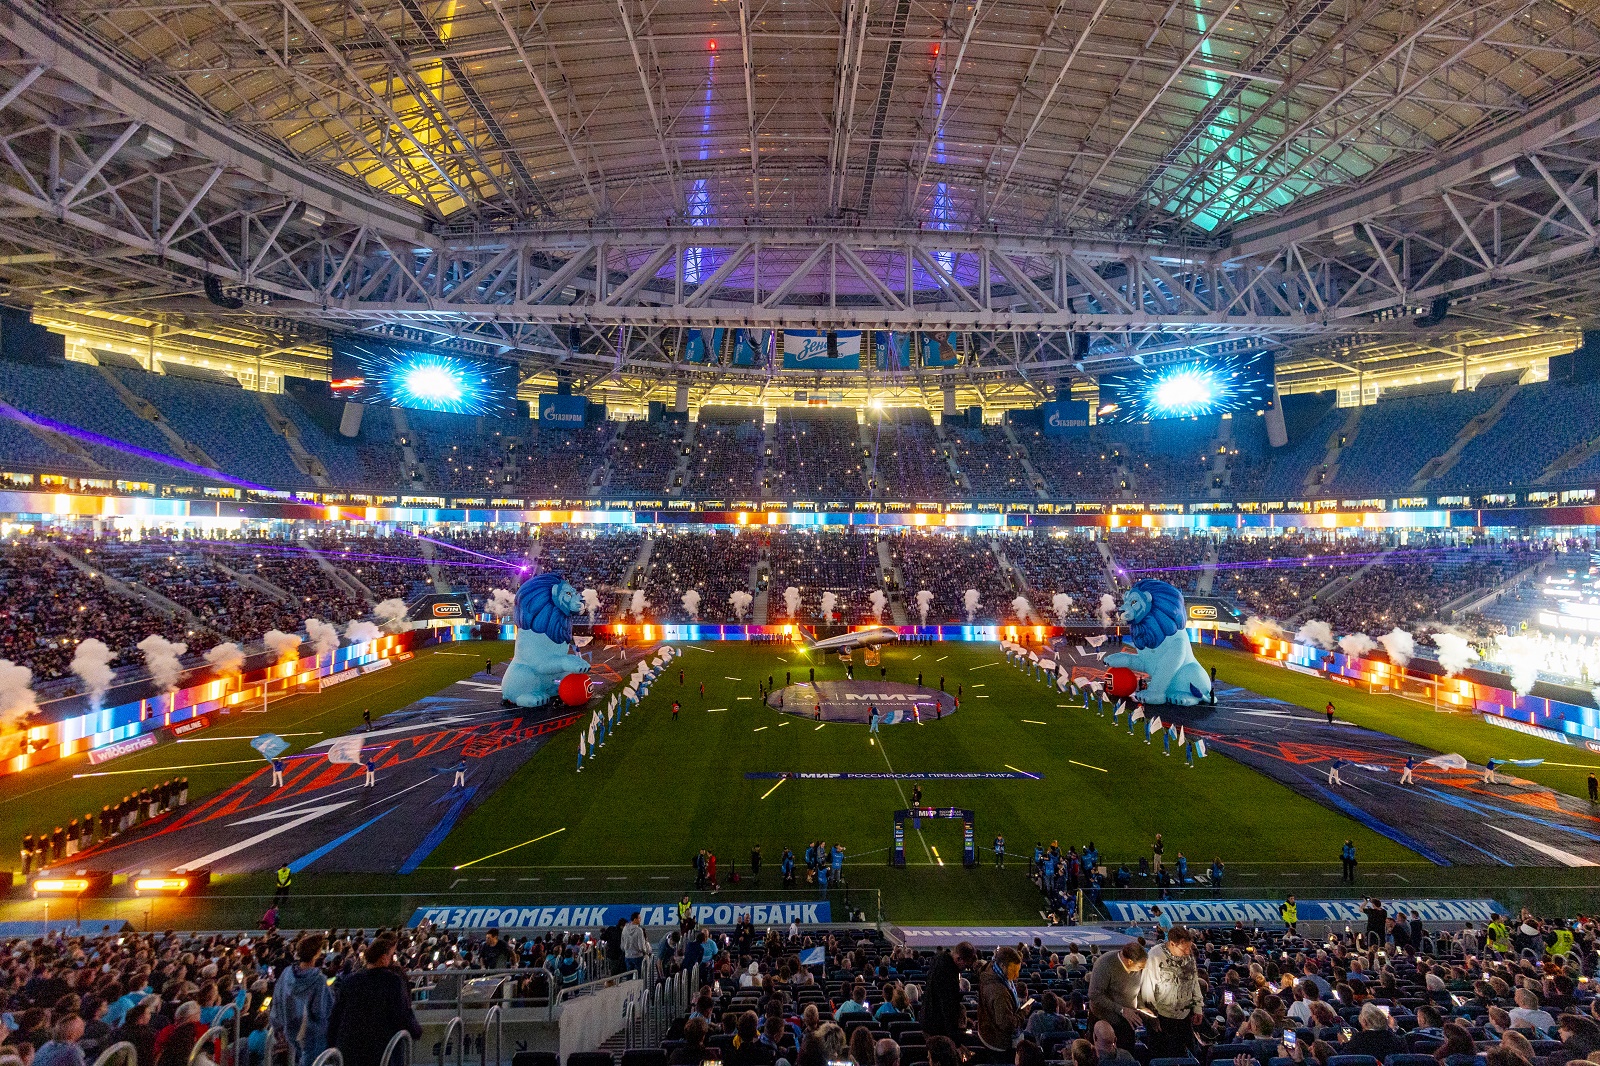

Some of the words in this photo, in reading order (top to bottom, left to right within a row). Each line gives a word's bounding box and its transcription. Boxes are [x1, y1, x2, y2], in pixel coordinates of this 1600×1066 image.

[555, 413, 582, 421] ГАЗПРОМ
[845, 693, 932, 701] МИР
[175, 720, 203, 735] WINLINE
[97, 737, 153, 761] wildberries
[418, 907, 609, 928] ГАЗПРОМБАНК
[1116, 902, 1284, 922] ГАЗПРОМБАН
[1318, 901, 1497, 921] ГАЗРОМБАНК
